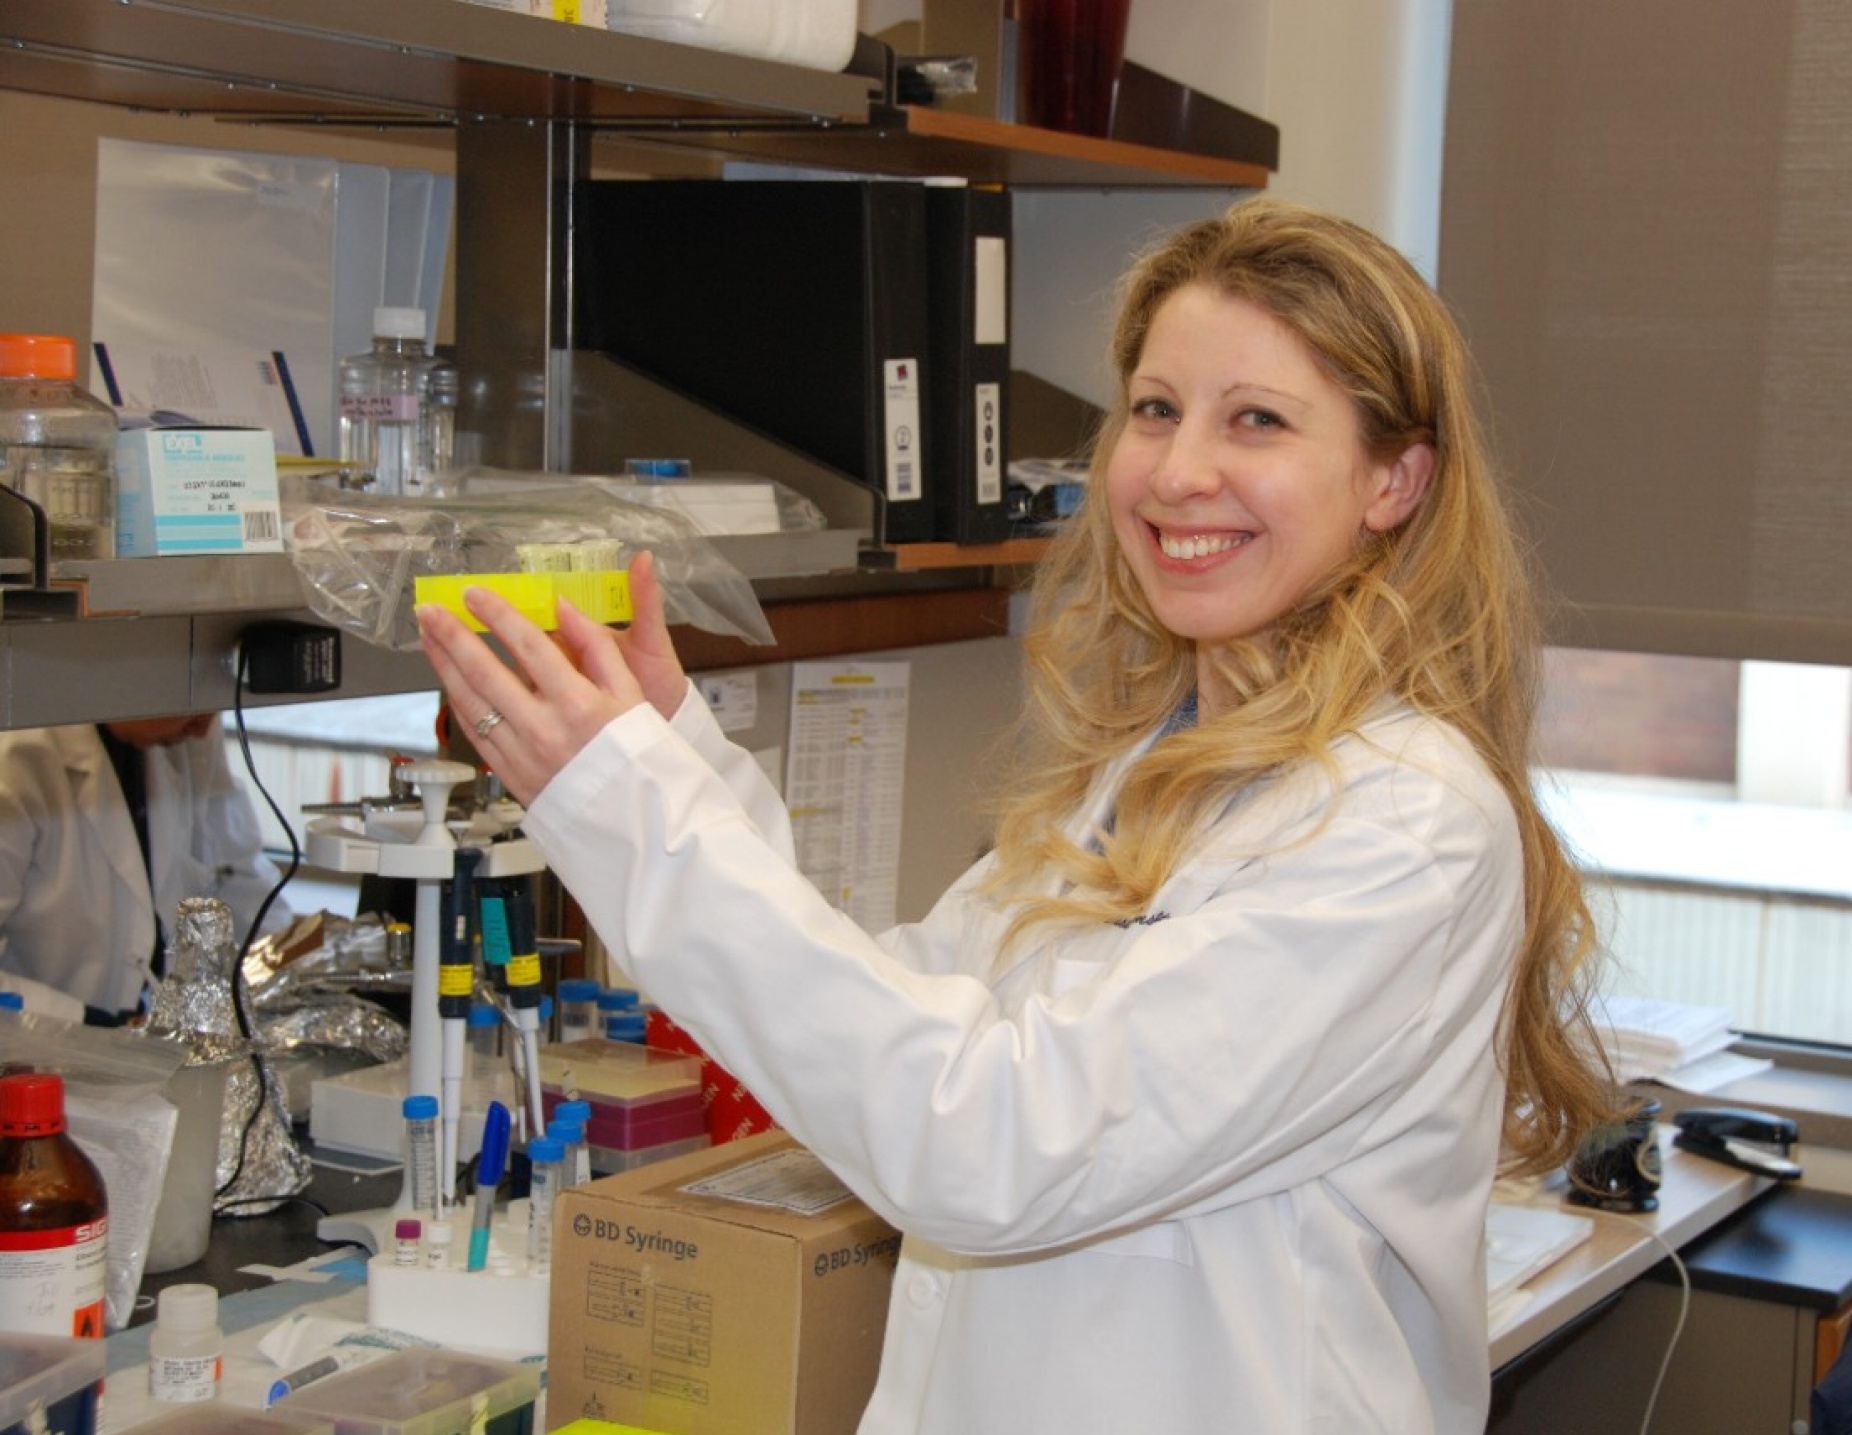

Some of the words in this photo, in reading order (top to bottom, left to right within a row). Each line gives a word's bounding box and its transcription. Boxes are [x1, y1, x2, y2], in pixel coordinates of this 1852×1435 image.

[595, 1219, 620, 1241] BD
[625, 1226, 698, 1261] Syringe
[830, 1248, 850, 1270] BD
